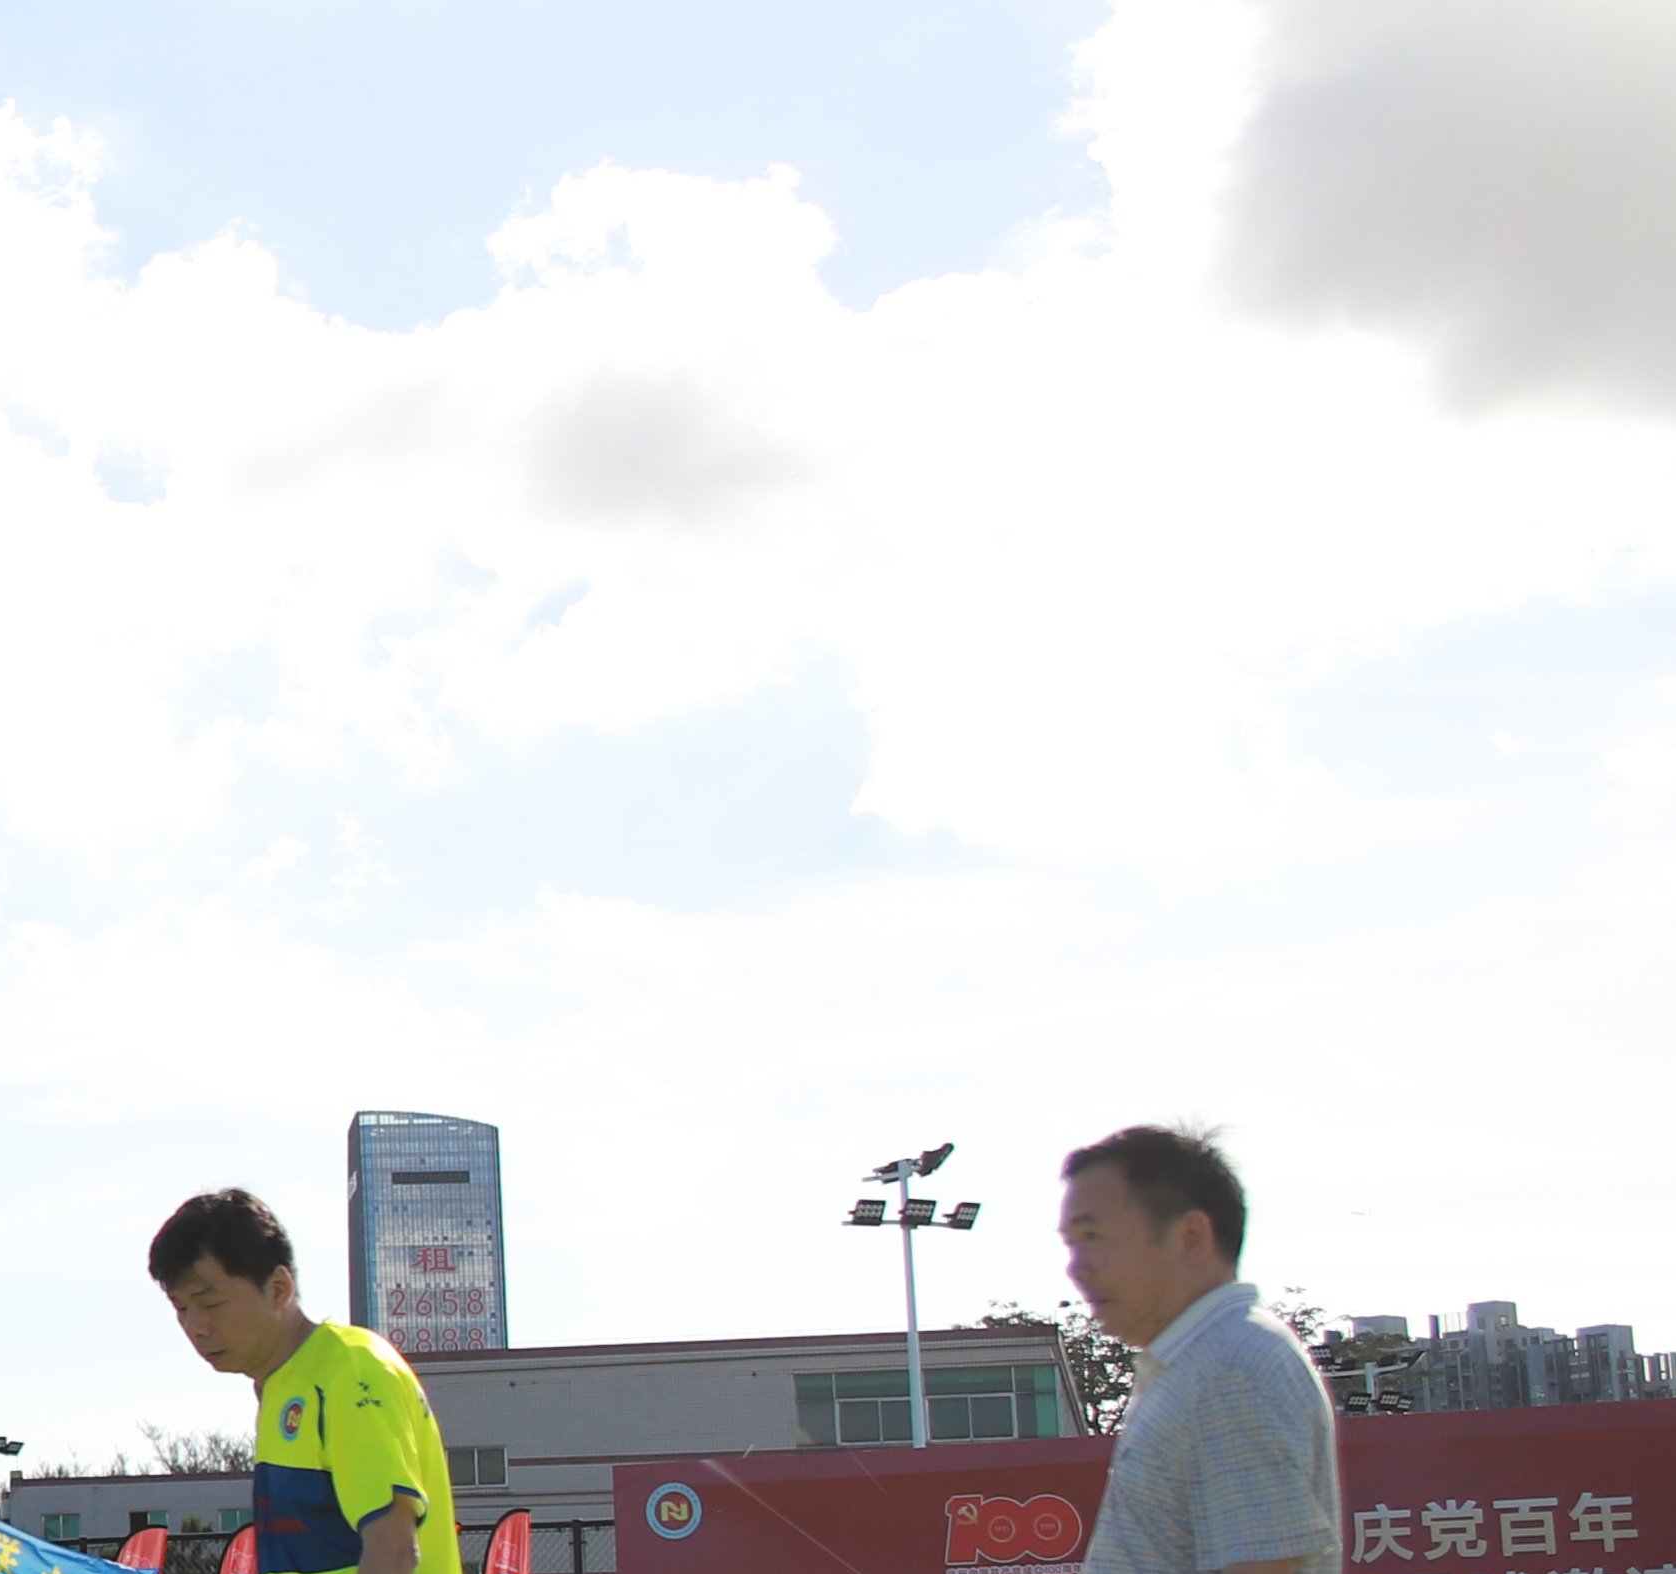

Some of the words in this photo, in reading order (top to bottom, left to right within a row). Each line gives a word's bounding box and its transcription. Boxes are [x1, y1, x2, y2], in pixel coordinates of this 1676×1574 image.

[412, 1247, 456, 1273] 租
[390, 1288, 484, 1317] 2658
[1351, 1493, 1638, 1563] 庆党百年
